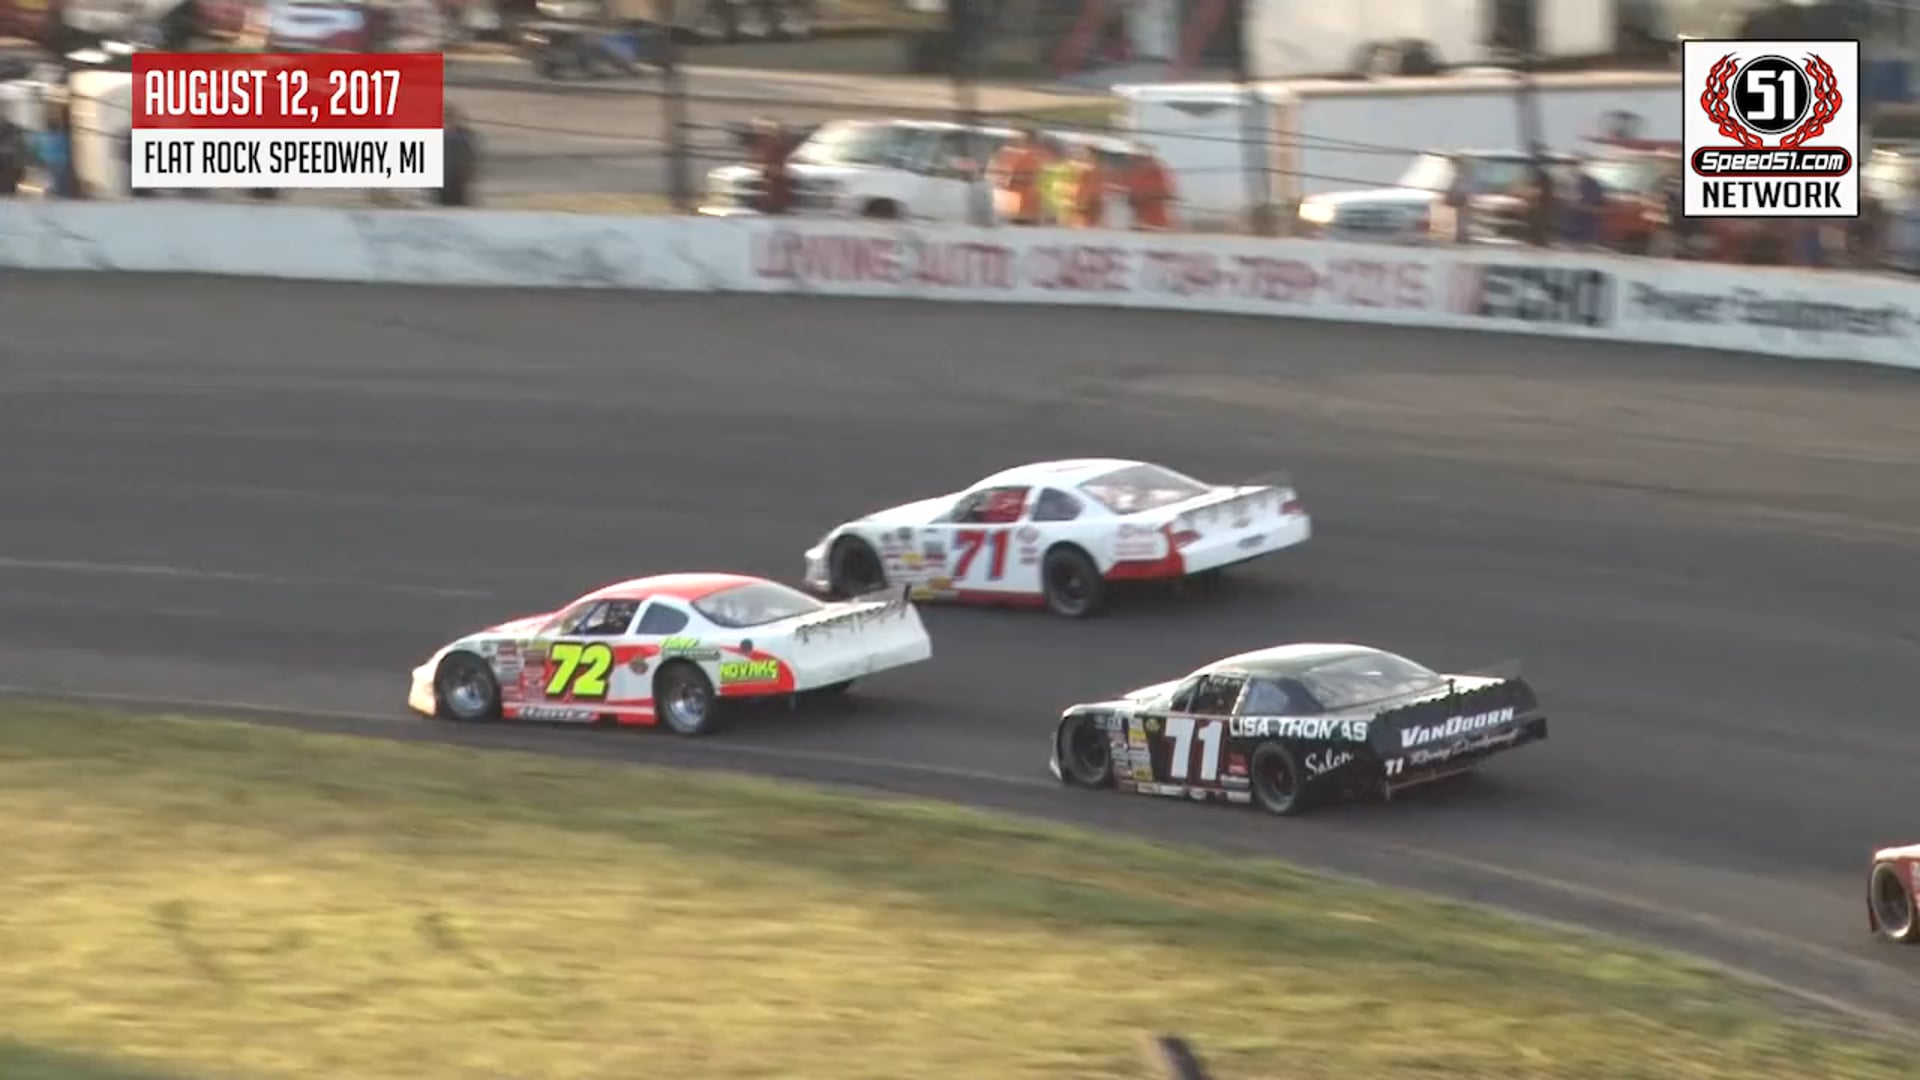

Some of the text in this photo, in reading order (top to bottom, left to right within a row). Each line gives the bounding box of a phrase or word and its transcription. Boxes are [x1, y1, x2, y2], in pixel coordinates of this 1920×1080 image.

[914, 241, 1014, 290] AUTO
[1027, 245, 1131, 292] CARE
[1478, 263, 1611, 327] ECHO
[954, 529, 1009, 581] 71
[547, 642, 614, 698] 72
[1164, 717, 1222, 780] 71
[1229, 716, 1270, 738] LISA
[1384, 757, 1404, 776] 71
